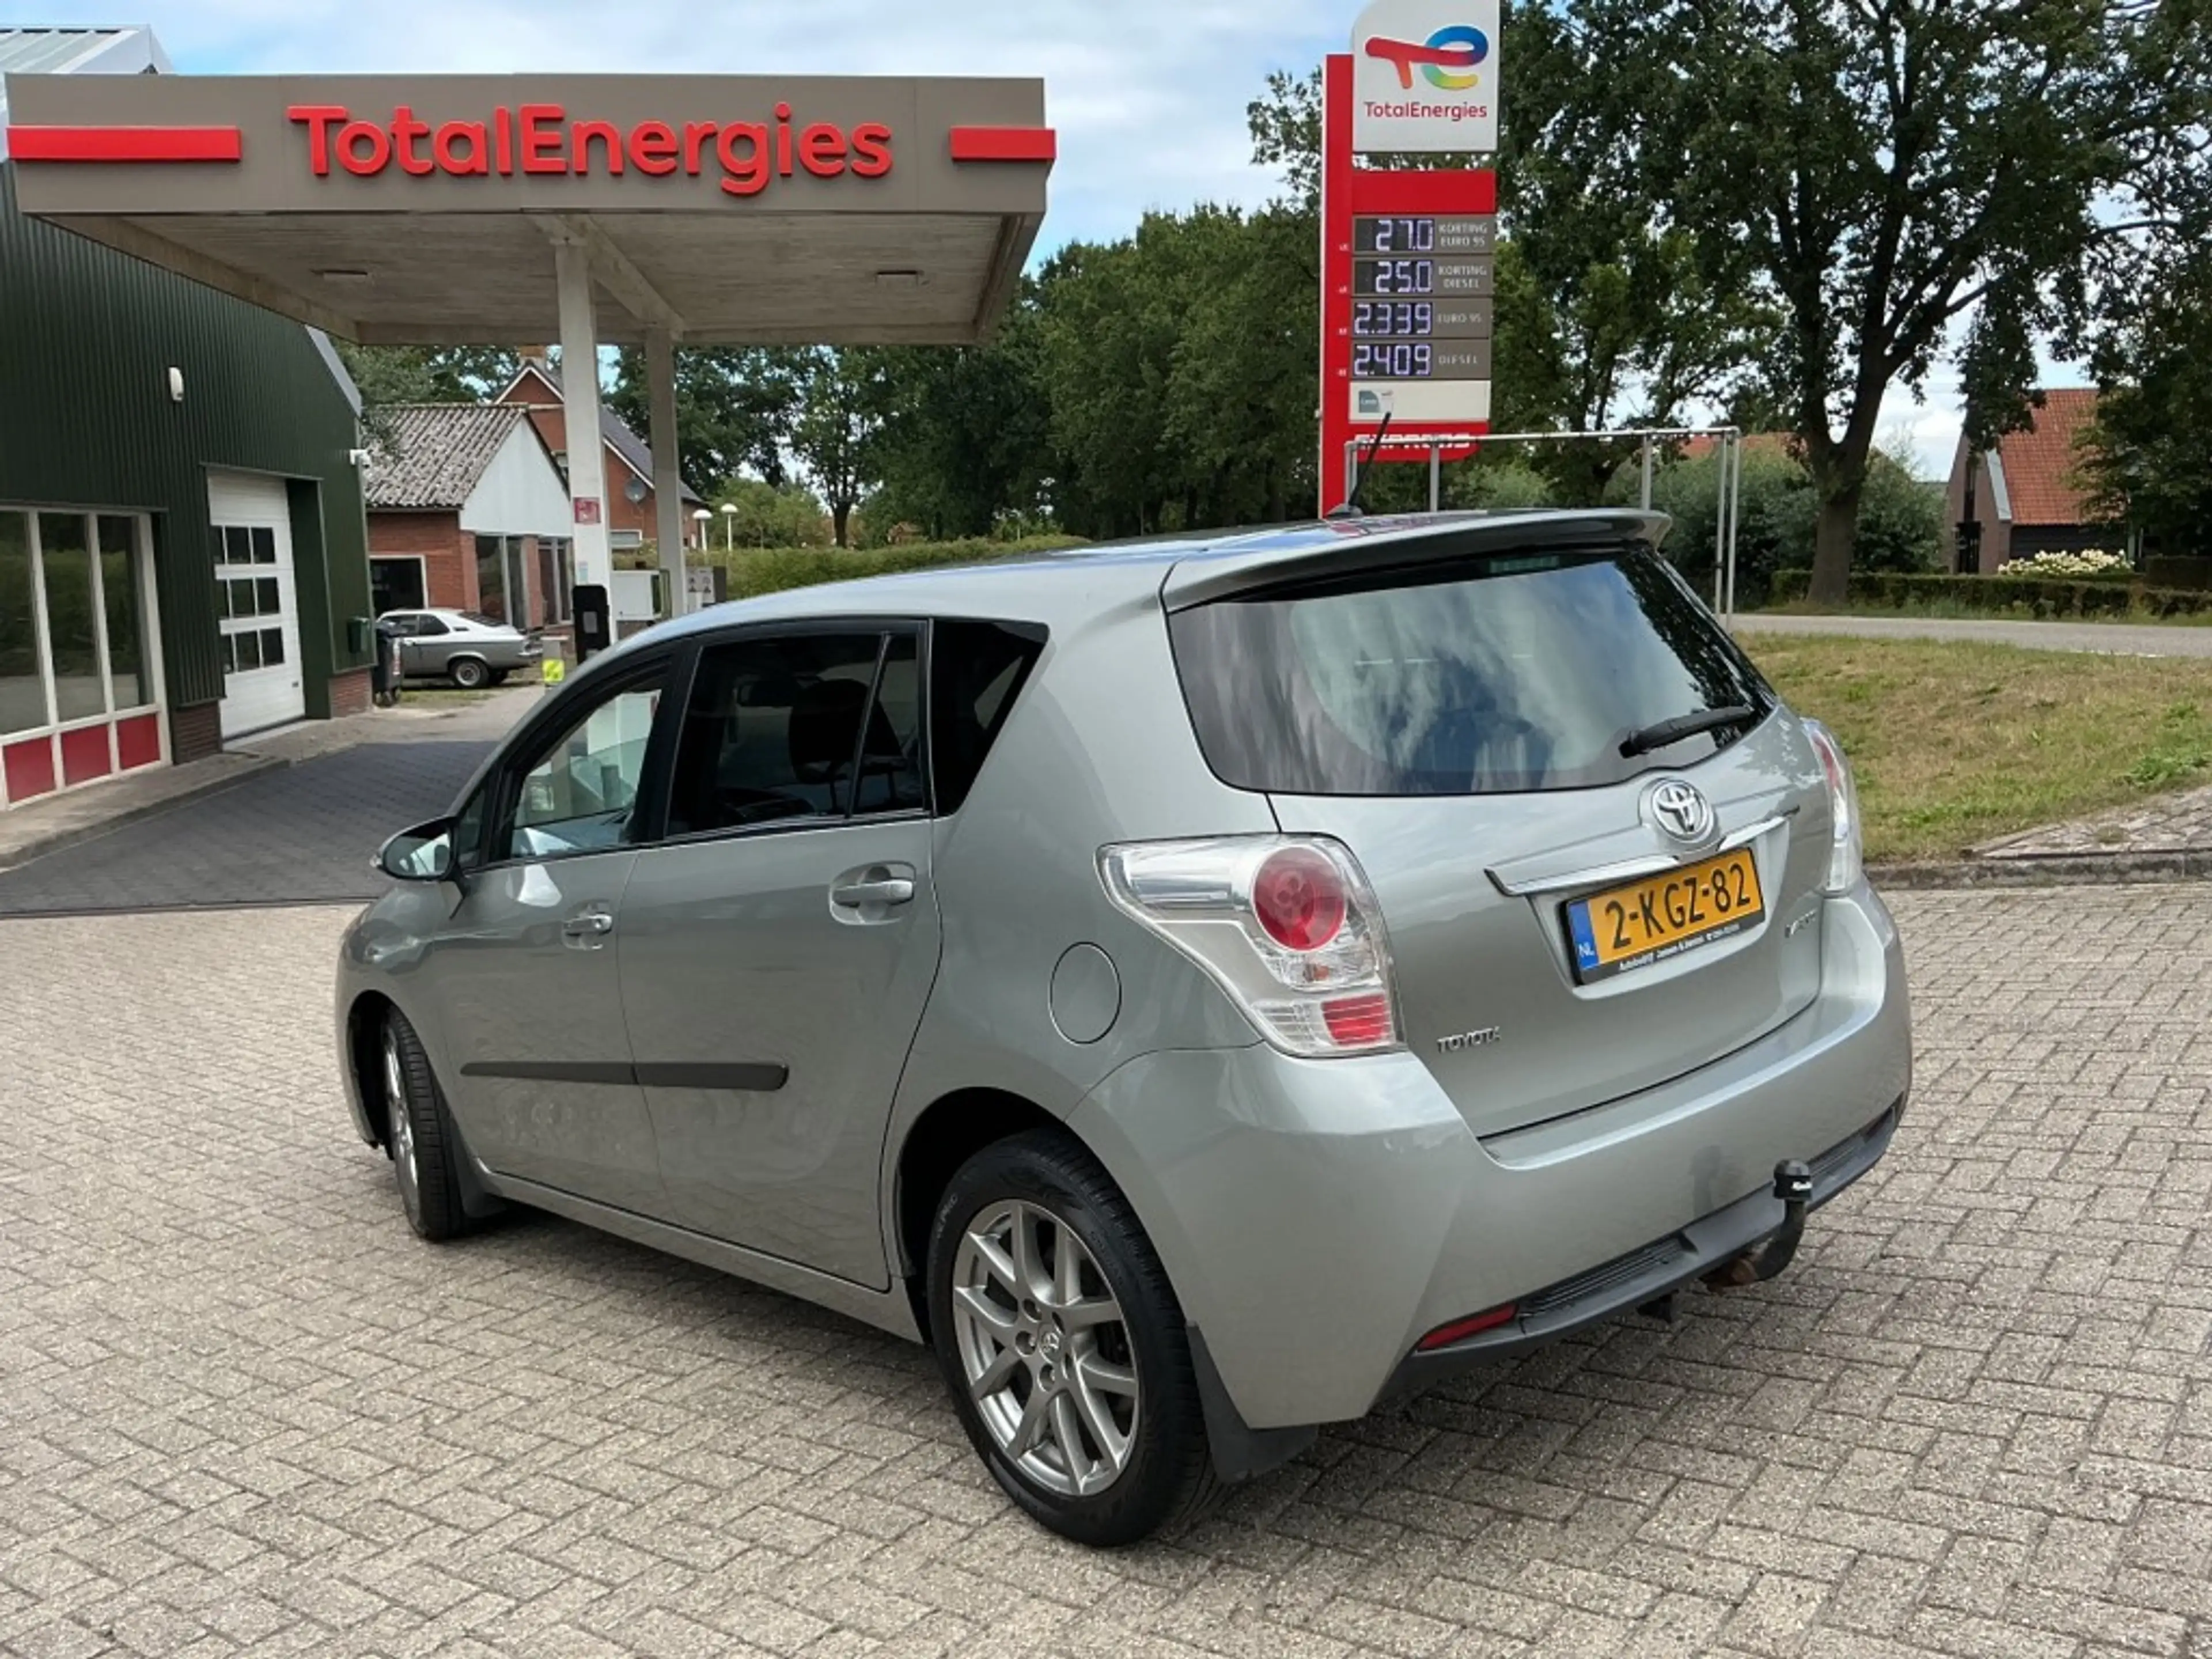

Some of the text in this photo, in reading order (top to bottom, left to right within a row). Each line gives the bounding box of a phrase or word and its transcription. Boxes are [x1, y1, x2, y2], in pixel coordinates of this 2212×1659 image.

[1363, 101, 1487, 122] TotalEnergies
[286, 103, 892, 194] TotalEnergies
[1438, 222, 1487, 234] KORTING
[1441, 236, 1485, 247] EURO 95
[1438, 266, 1487, 275] KORTING
[1443, 278, 1479, 288] DIESEL
[1354, 304, 1431, 334] 2.339
[1437, 313, 1468, 323] EURO
[1354, 345, 1431, 375] 2.409
[1438, 353, 1478, 364] DIESEL
[1605, 863, 1751, 949] 2-KGZ-82
[1578, 942, 1595, 959] NL
